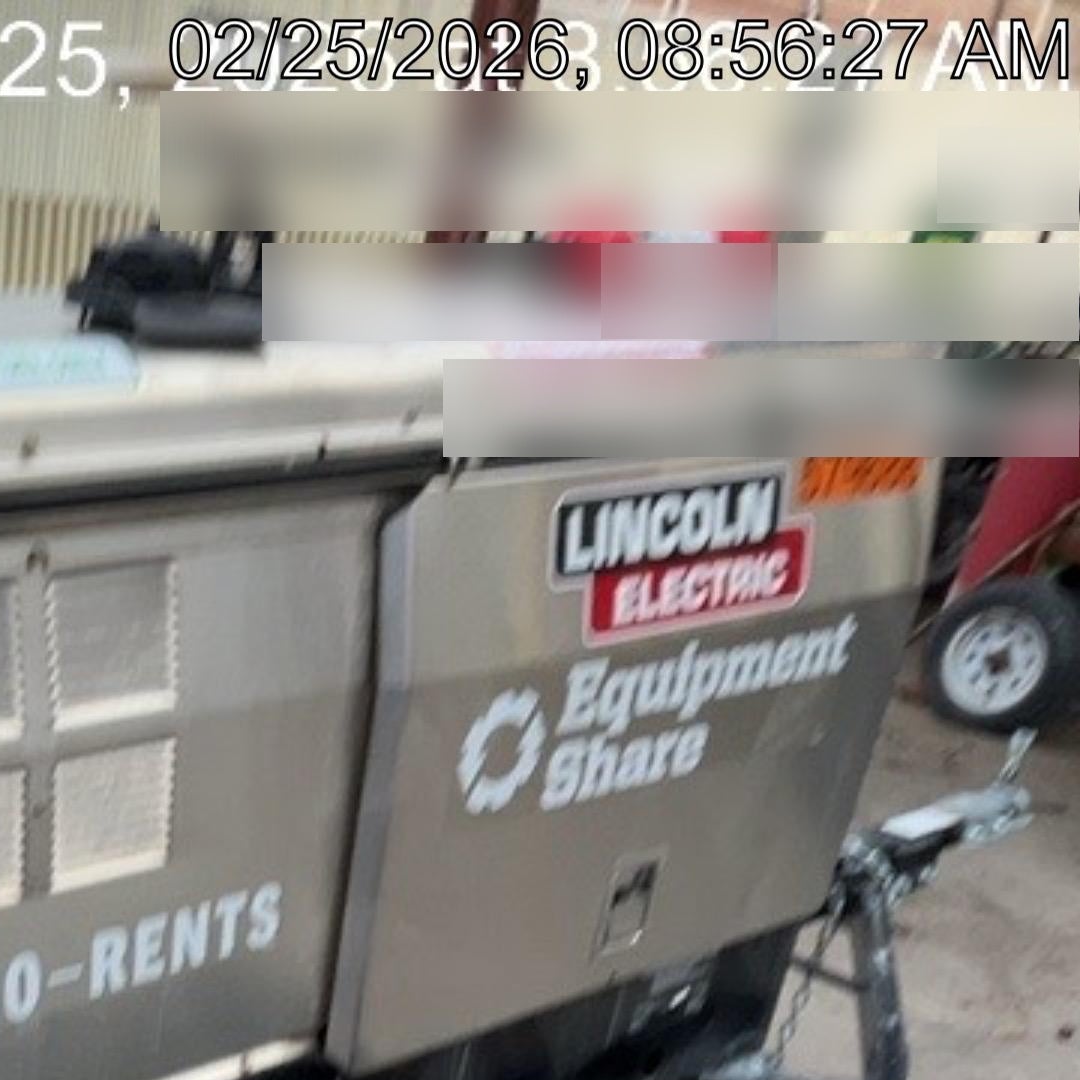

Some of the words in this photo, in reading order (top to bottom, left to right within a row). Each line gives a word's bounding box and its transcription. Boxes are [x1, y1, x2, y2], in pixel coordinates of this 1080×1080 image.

[564, 477, 777, 573] LINCOLN
[612, 549, 790, 628] ELECTRIC
[555, 612, 858, 737] Equipment
[540, 722, 710, 812] Share
